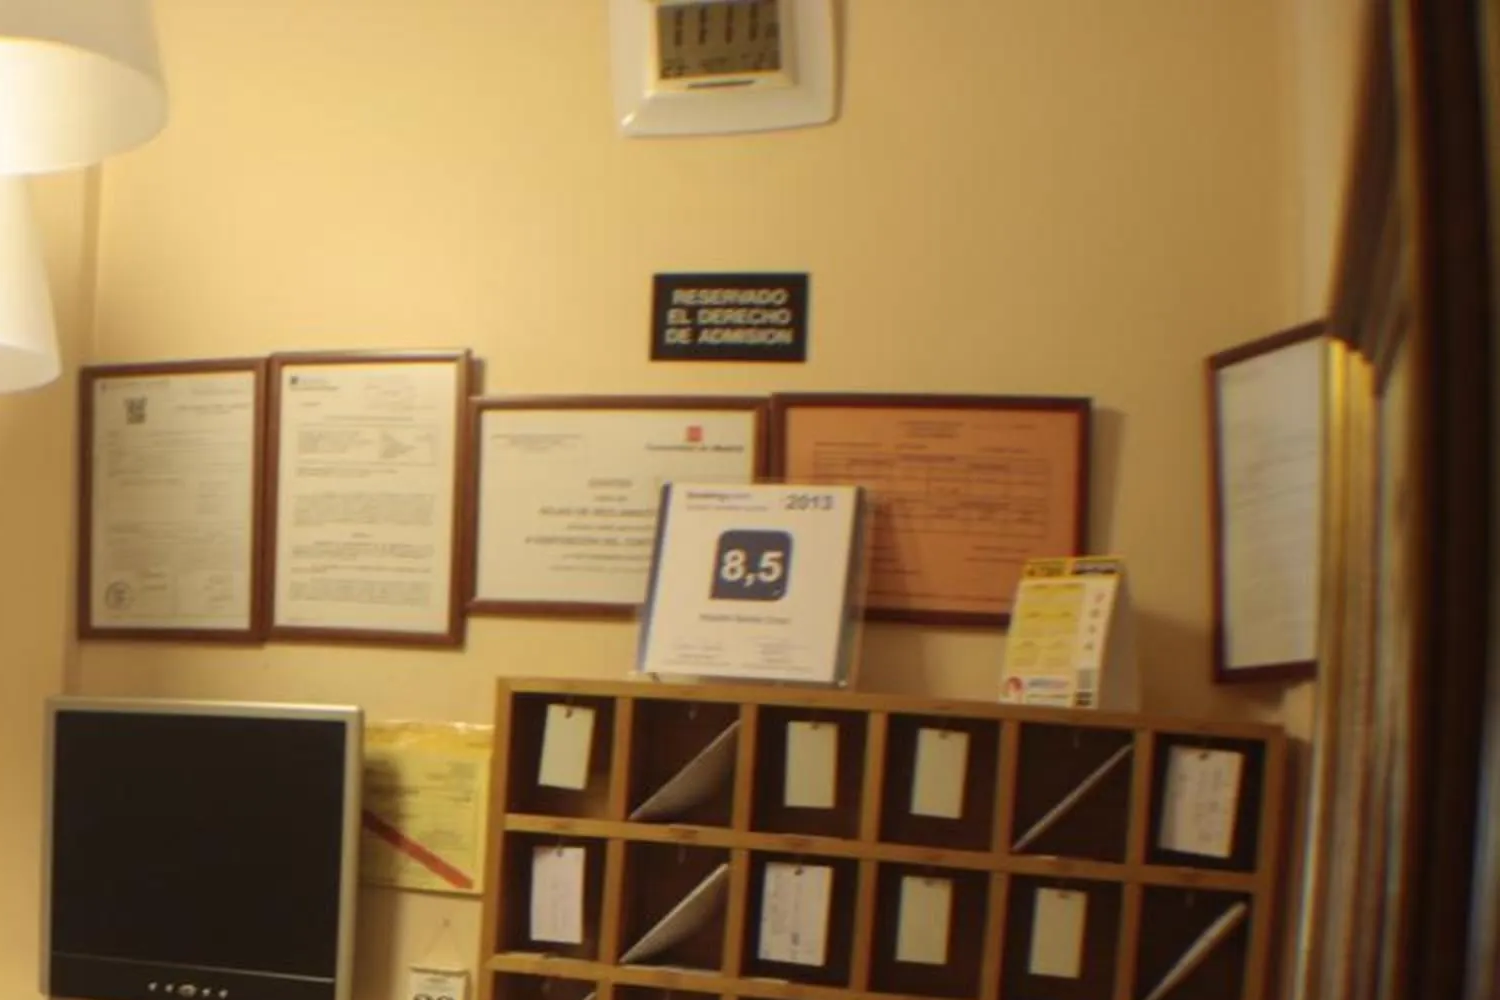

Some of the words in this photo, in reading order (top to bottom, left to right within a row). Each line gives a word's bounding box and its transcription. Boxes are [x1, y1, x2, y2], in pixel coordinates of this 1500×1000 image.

[672, 288, 789, 306] RESERVADO
[666, 307, 692, 326] EL
[697, 307, 792, 326] DERECHO
[664, 326, 694, 345] DE
[698, 326, 794, 345] ADMISION
[785, 494, 834, 511] 2013
[720, 548, 784, 588] 8,5
